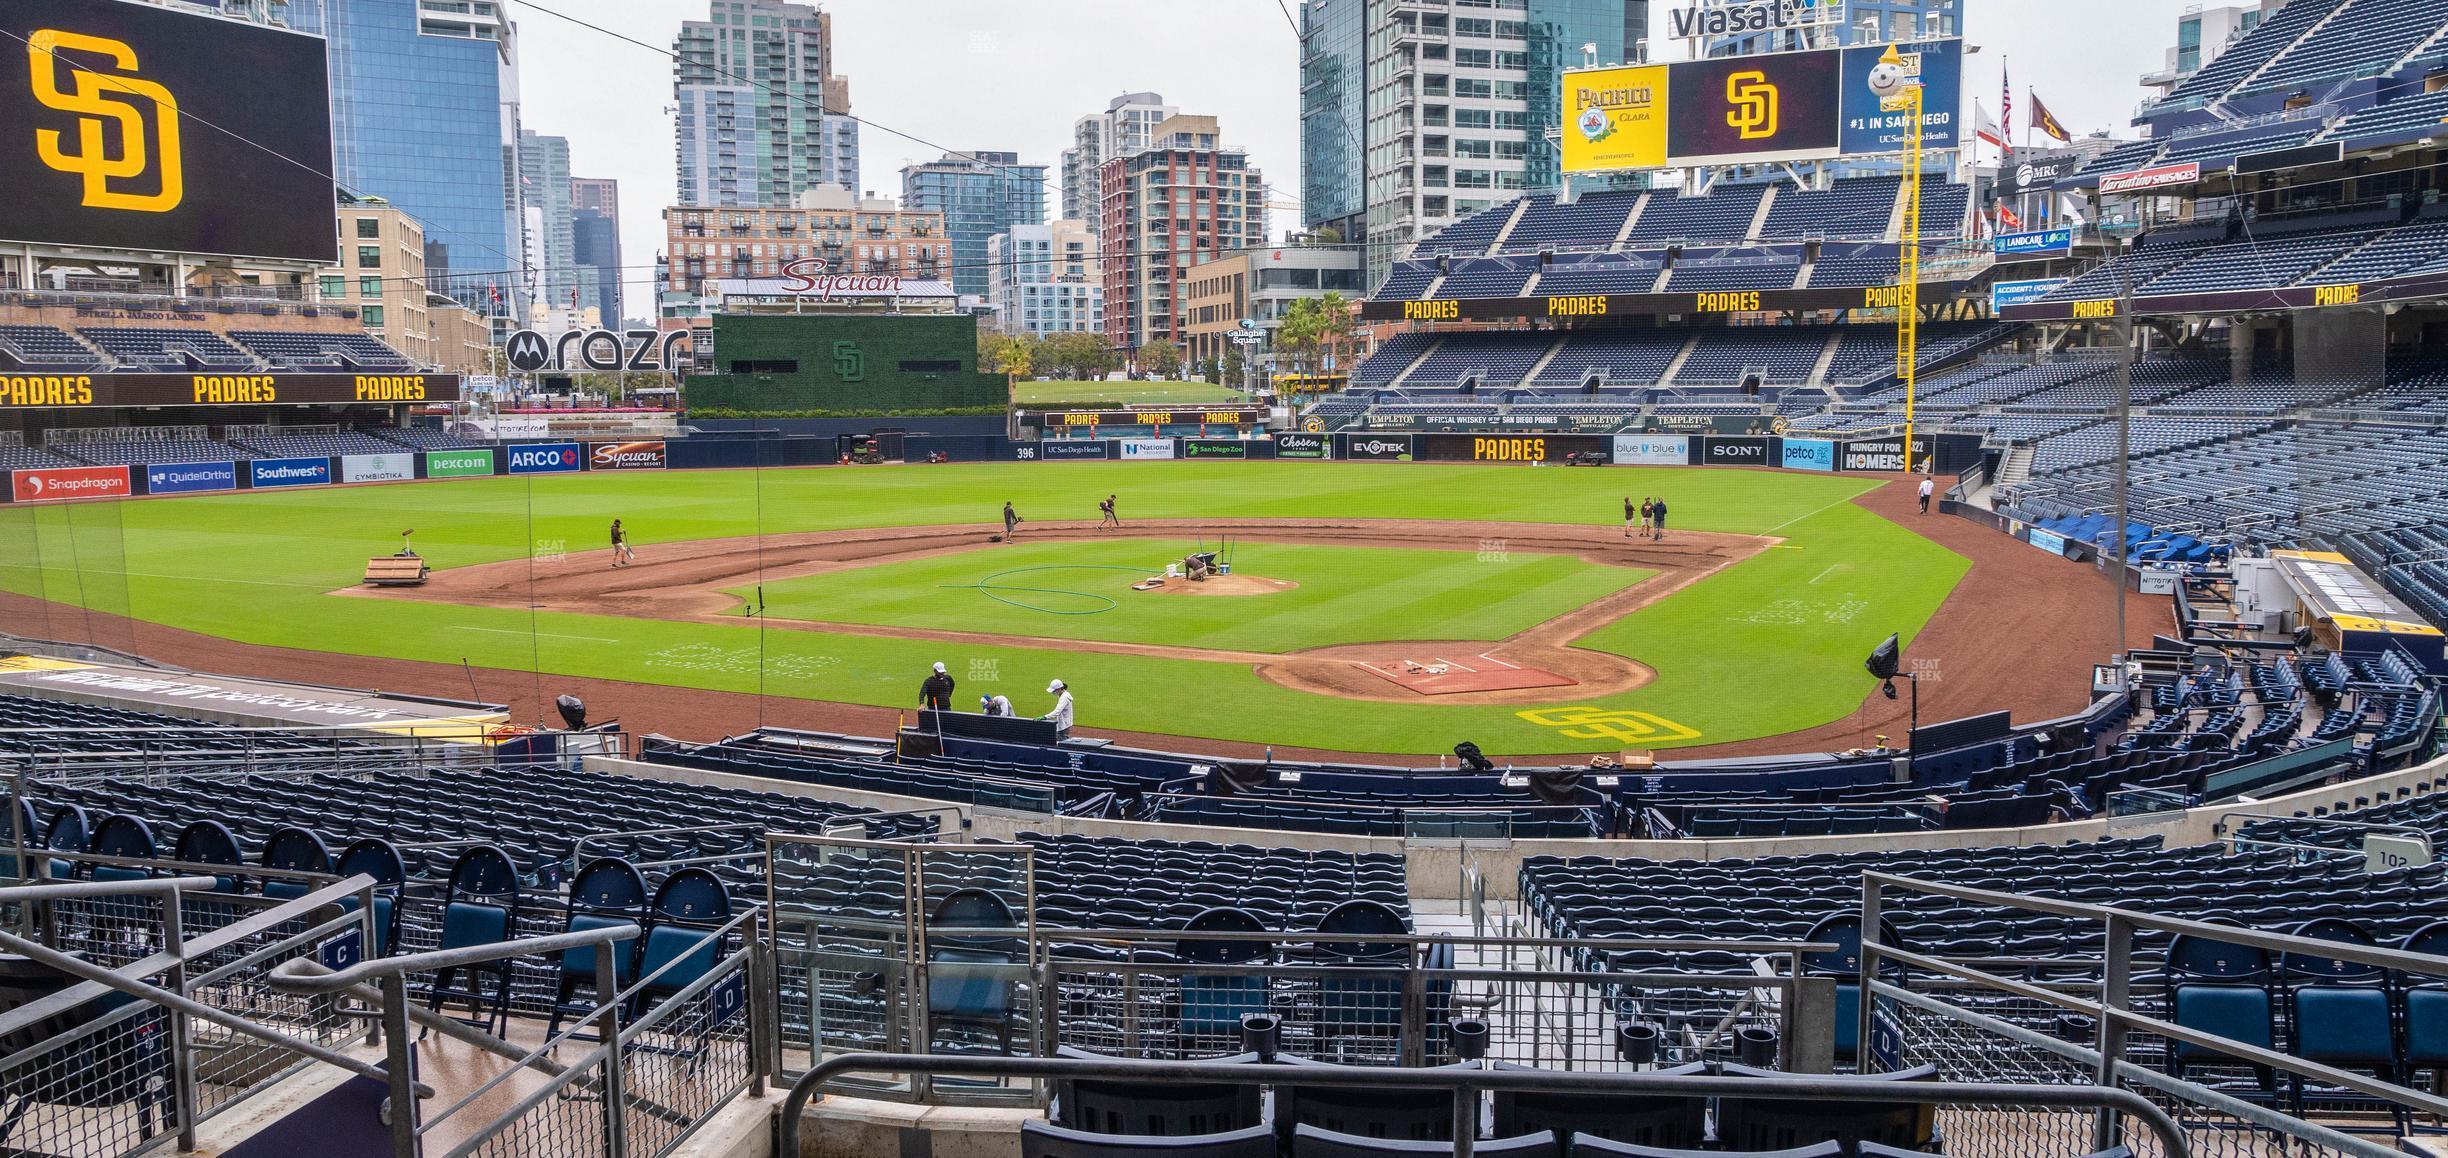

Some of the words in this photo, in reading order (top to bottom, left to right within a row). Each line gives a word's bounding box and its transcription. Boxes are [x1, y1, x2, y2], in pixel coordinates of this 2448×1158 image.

[1672, 0, 1788, 37] Viasat
[1850, 118, 1865, 130] #1
[1869, 117, 1882, 129] IN
[1925, 132, 1948, 140] Health
[2033, 164, 2059, 178] MRC
[2101, 173, 2152, 191] Tarantino
[2152, 170, 2195, 184] SAUSAGES
[2007, 235, 2043, 246] LANDCARE
[782, 257, 903, 302] Sycuan
[1697, 291, 1759, 312] PADRES
[1865, 286, 1911, 307] PADRES
[2315, 284, 2359, 305] PADRES
[1404, 300, 1458, 319] PADRES
[1548, 296, 1607, 315] PADRES
[2073, 301, 2115, 318] PADRES
[166, 312, 206, 321] LANDING
[1227, 329, 1266, 338] Gallagher
[1232, 336, 1261, 344] Square
[556, 329, 690, 371] razr
[193, 376, 275, 403] PADRES
[355, 376, 425, 400] PADRES
[1064, 414, 1099, 425] PADRES
[1136, 413, 1171, 424] PADRES
[1206, 412, 1240, 423] PADRES
[1367, 415, 1415, 424] TEMPLETON
[1426, 416, 1455, 424] OFFICIAL
[1456, 416, 1487, 424] WHISKEY
[1502, 416, 1514, 424] SAN
[1516, 416, 1533, 424] DIEGO
[1534, 416, 1558, 424] PADRES
[1569, 415, 1624, 425] TEMPLETON
[1657, 416, 1713, 425] TEMPLETON
[1280, 435, 1320, 447] Chosen
[1850, 443, 1883, 452] HUNGRY
[1885, 443, 1901, 452] FOR
[1017, 447, 1034, 459] 396
[1474, 437, 1545, 460] PADRES
[1617, 444, 1639, 453] blue
[1652, 444, 1675, 453] blue
[1713, 445, 1763, 456] SONY
[1785, 446, 1815, 460] petco
[511, 450, 560, 467] ARCO
[595, 445, 658, 468] Sycuan
[1846, 454, 1905, 469] HOMERS
[170, 471, 231, 483] QuidelOrtho
[256, 466, 318, 479] Southwest
[355, 472, 402, 480] CYMBIOTIKA
[48, 476, 123, 490] Snapdragon
[2380, 851, 2408, 867] 102
[337, 945, 347, 963] C
[725, 989, 733, 1009] D
[1882, 1031, 1889, 1053] D
